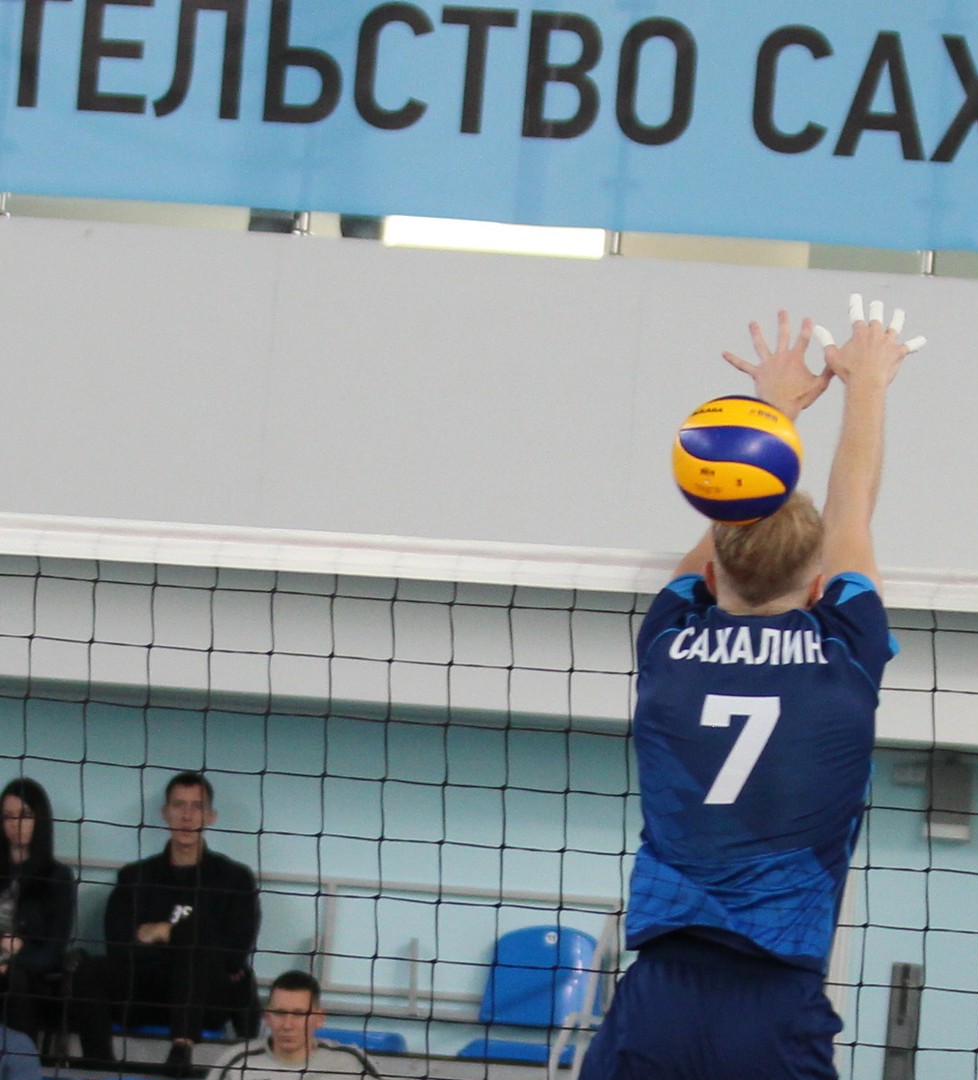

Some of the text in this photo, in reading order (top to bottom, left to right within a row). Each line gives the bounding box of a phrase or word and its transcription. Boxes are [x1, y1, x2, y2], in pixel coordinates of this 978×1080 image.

[4, 0, 697, 146] ТЕЛЬСТВО
[669, 625, 829, 666] САХАЛИН
[700, 693, 781, 805] 7
